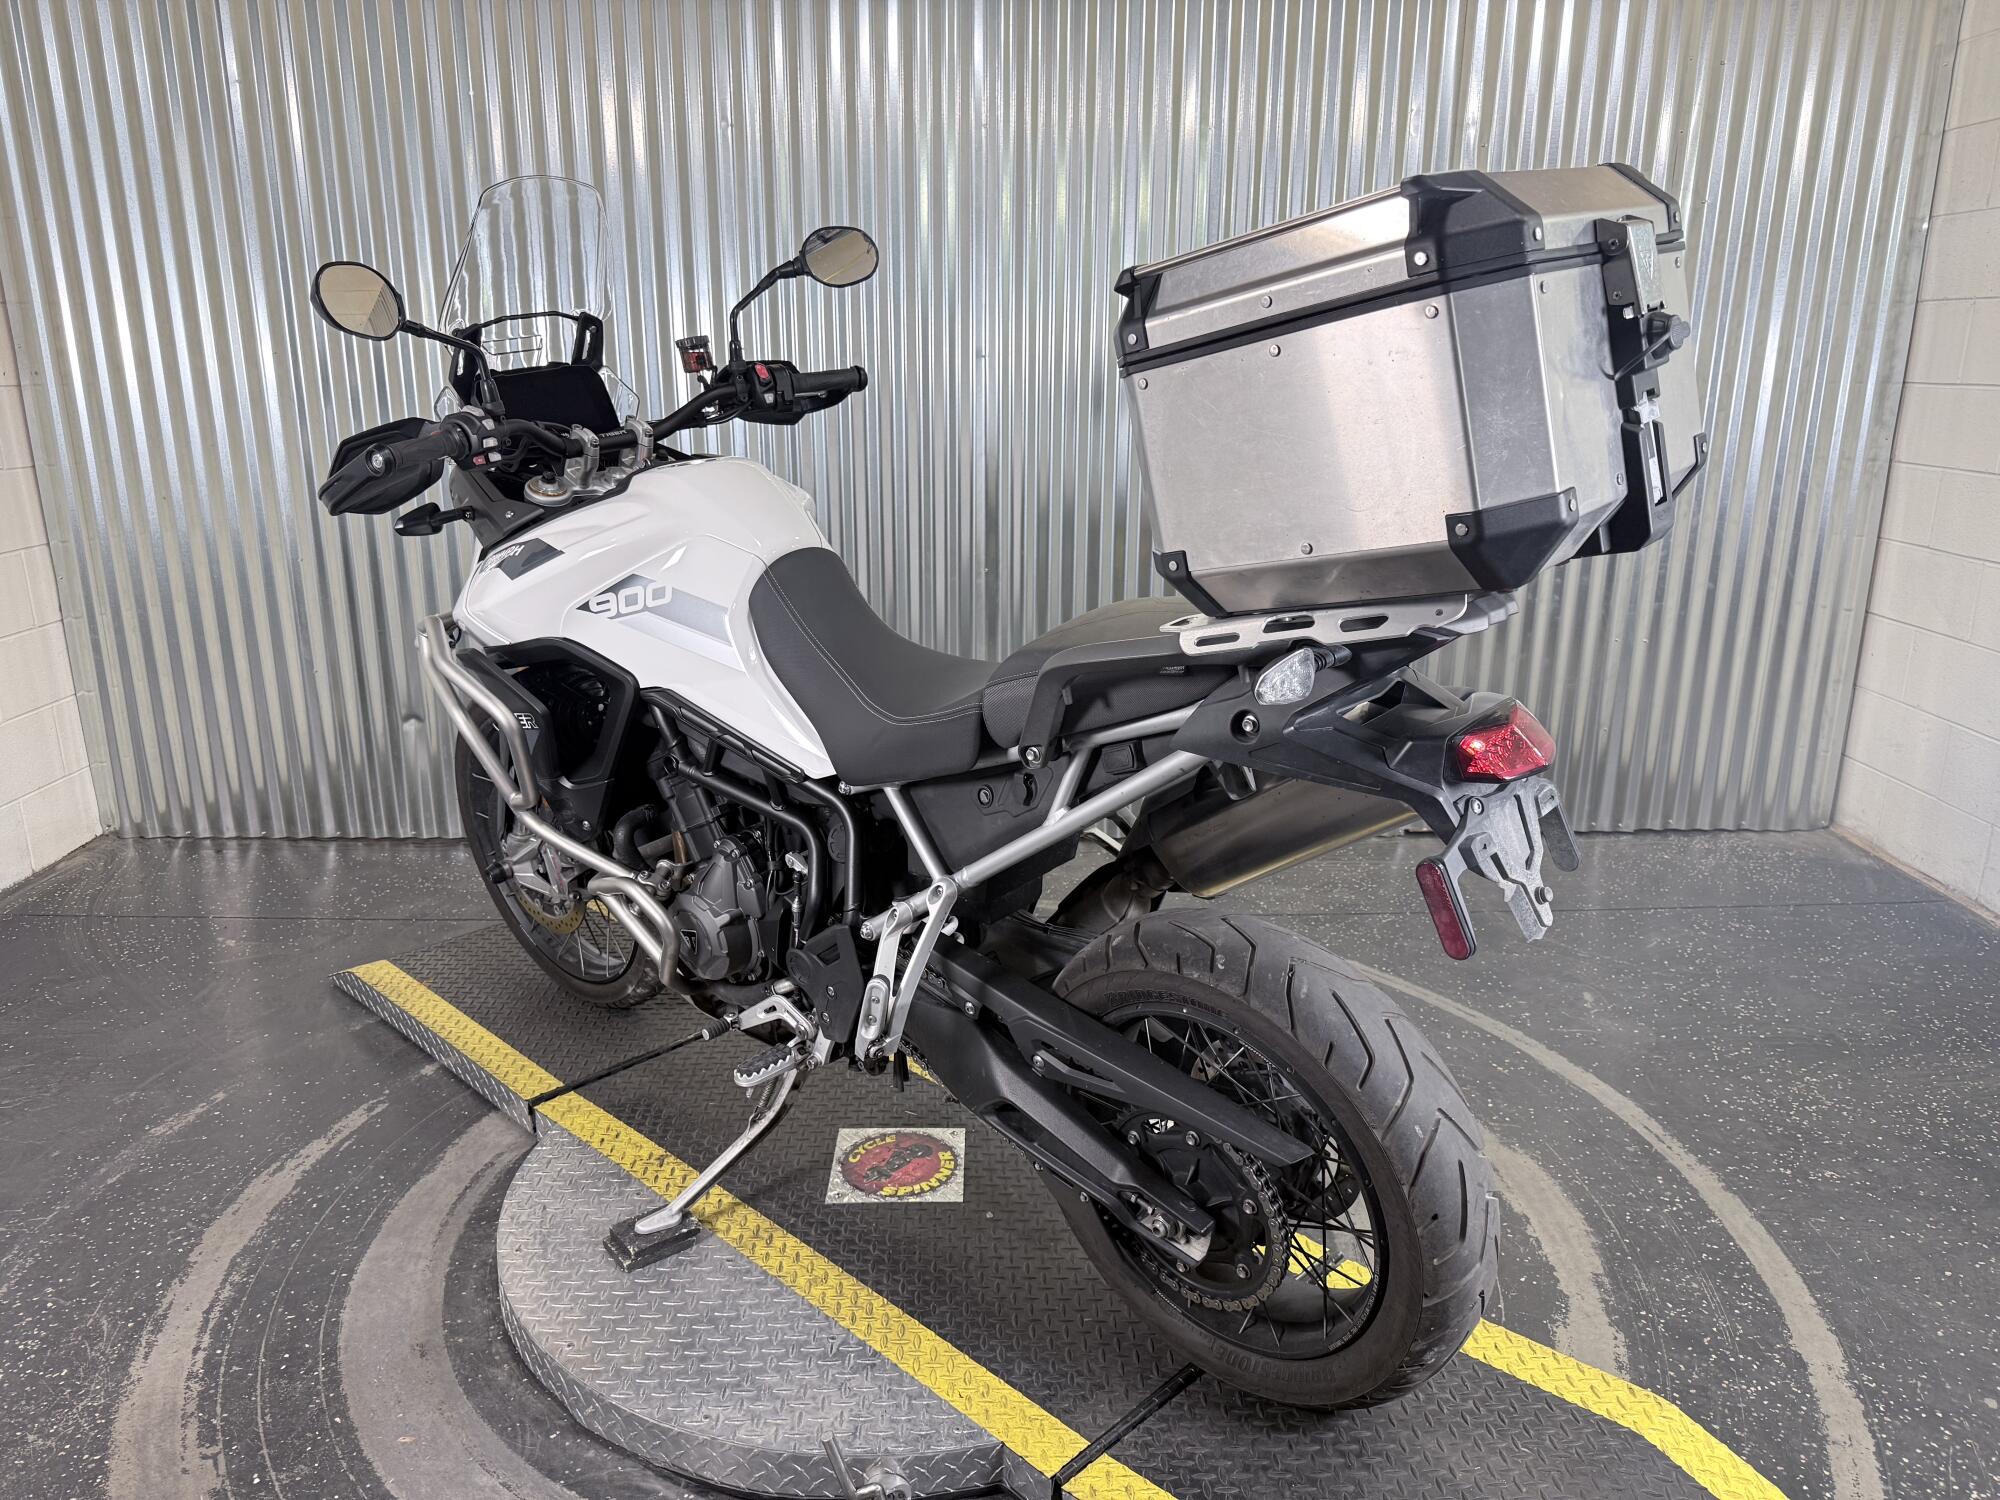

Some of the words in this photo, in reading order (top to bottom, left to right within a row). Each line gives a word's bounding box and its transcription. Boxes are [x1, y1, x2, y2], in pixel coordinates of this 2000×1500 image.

[589, 582, 673, 619] 900
[848, 1134, 897, 1163] CYCLE
[880, 1150, 955, 1197] SPINNER
